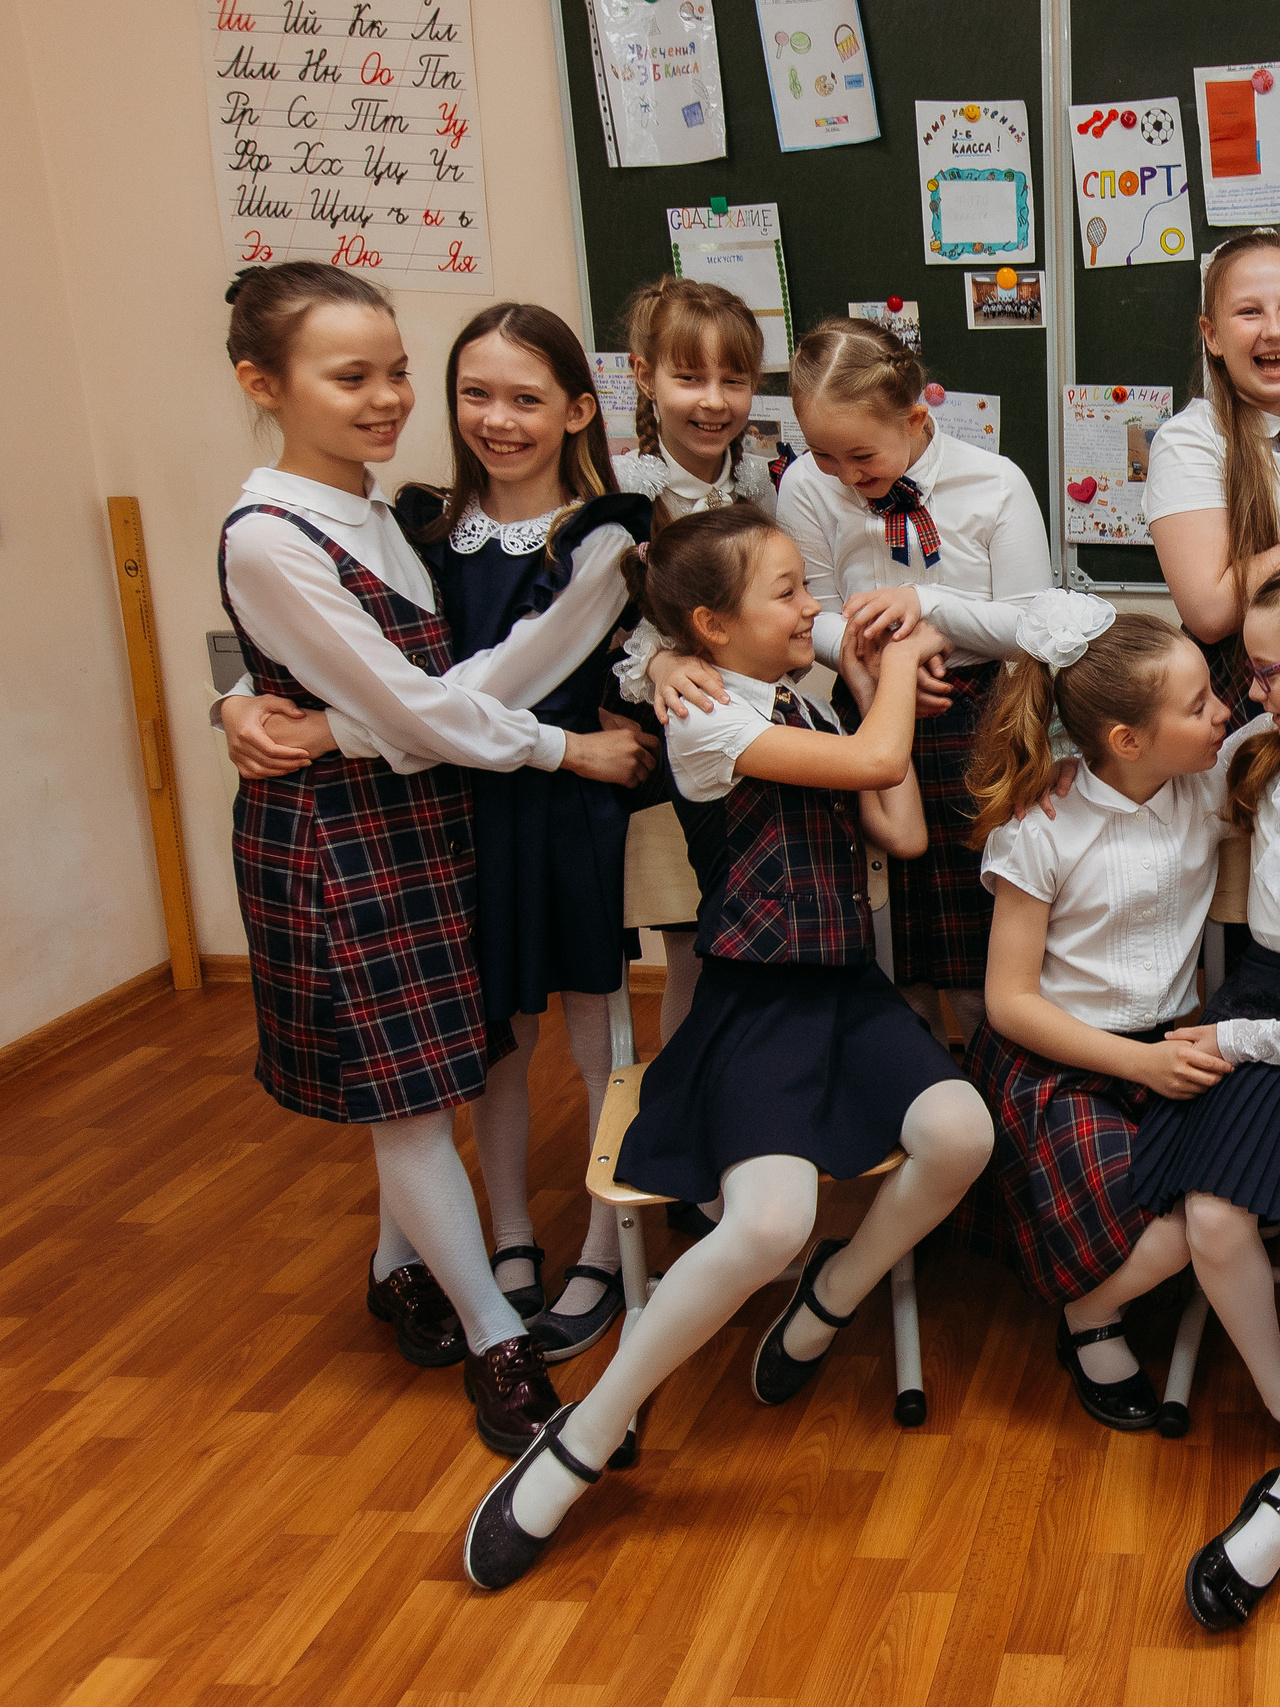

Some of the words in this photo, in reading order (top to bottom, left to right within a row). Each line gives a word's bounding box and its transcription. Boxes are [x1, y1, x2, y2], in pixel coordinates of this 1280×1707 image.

[348, 3, 388, 38] Кк
[411, 7, 458, 42] Лл
[217, 45, 280, 79] Мм
[299, 48, 342, 83] Нн
[361, 51, 395, 86] Оо
[412, 54, 462, 89] Пп
[221, 91, 261, 138] Рр
[287, 95, 318, 128] Сс
[344, 98, 409, 133] Тт
[436, 102, 468, 149] Уу
[228, 139, 272, 184] Фф
[290, 141, 344, 176] Хх
[364, 145, 408, 186] Цц
[429, 149, 465, 182] Чч
[1083, 164, 1182, 199] СПОРТ
[236, 184, 293, 219] Шш
[309, 188, 373, 229] Щщ
[387, 205, 409, 225] ъ
[423, 208, 445, 227] ы
[458, 209, 473, 228] ь
[670, 207, 773, 230] СОДЕРЖАНИЕ
[241, 230, 273, 262] Ээ
[331, 235, 383, 267] Юю
[438, 240, 477, 273] Яя
[1067, 386, 1171, 406] РИСОАНИе
